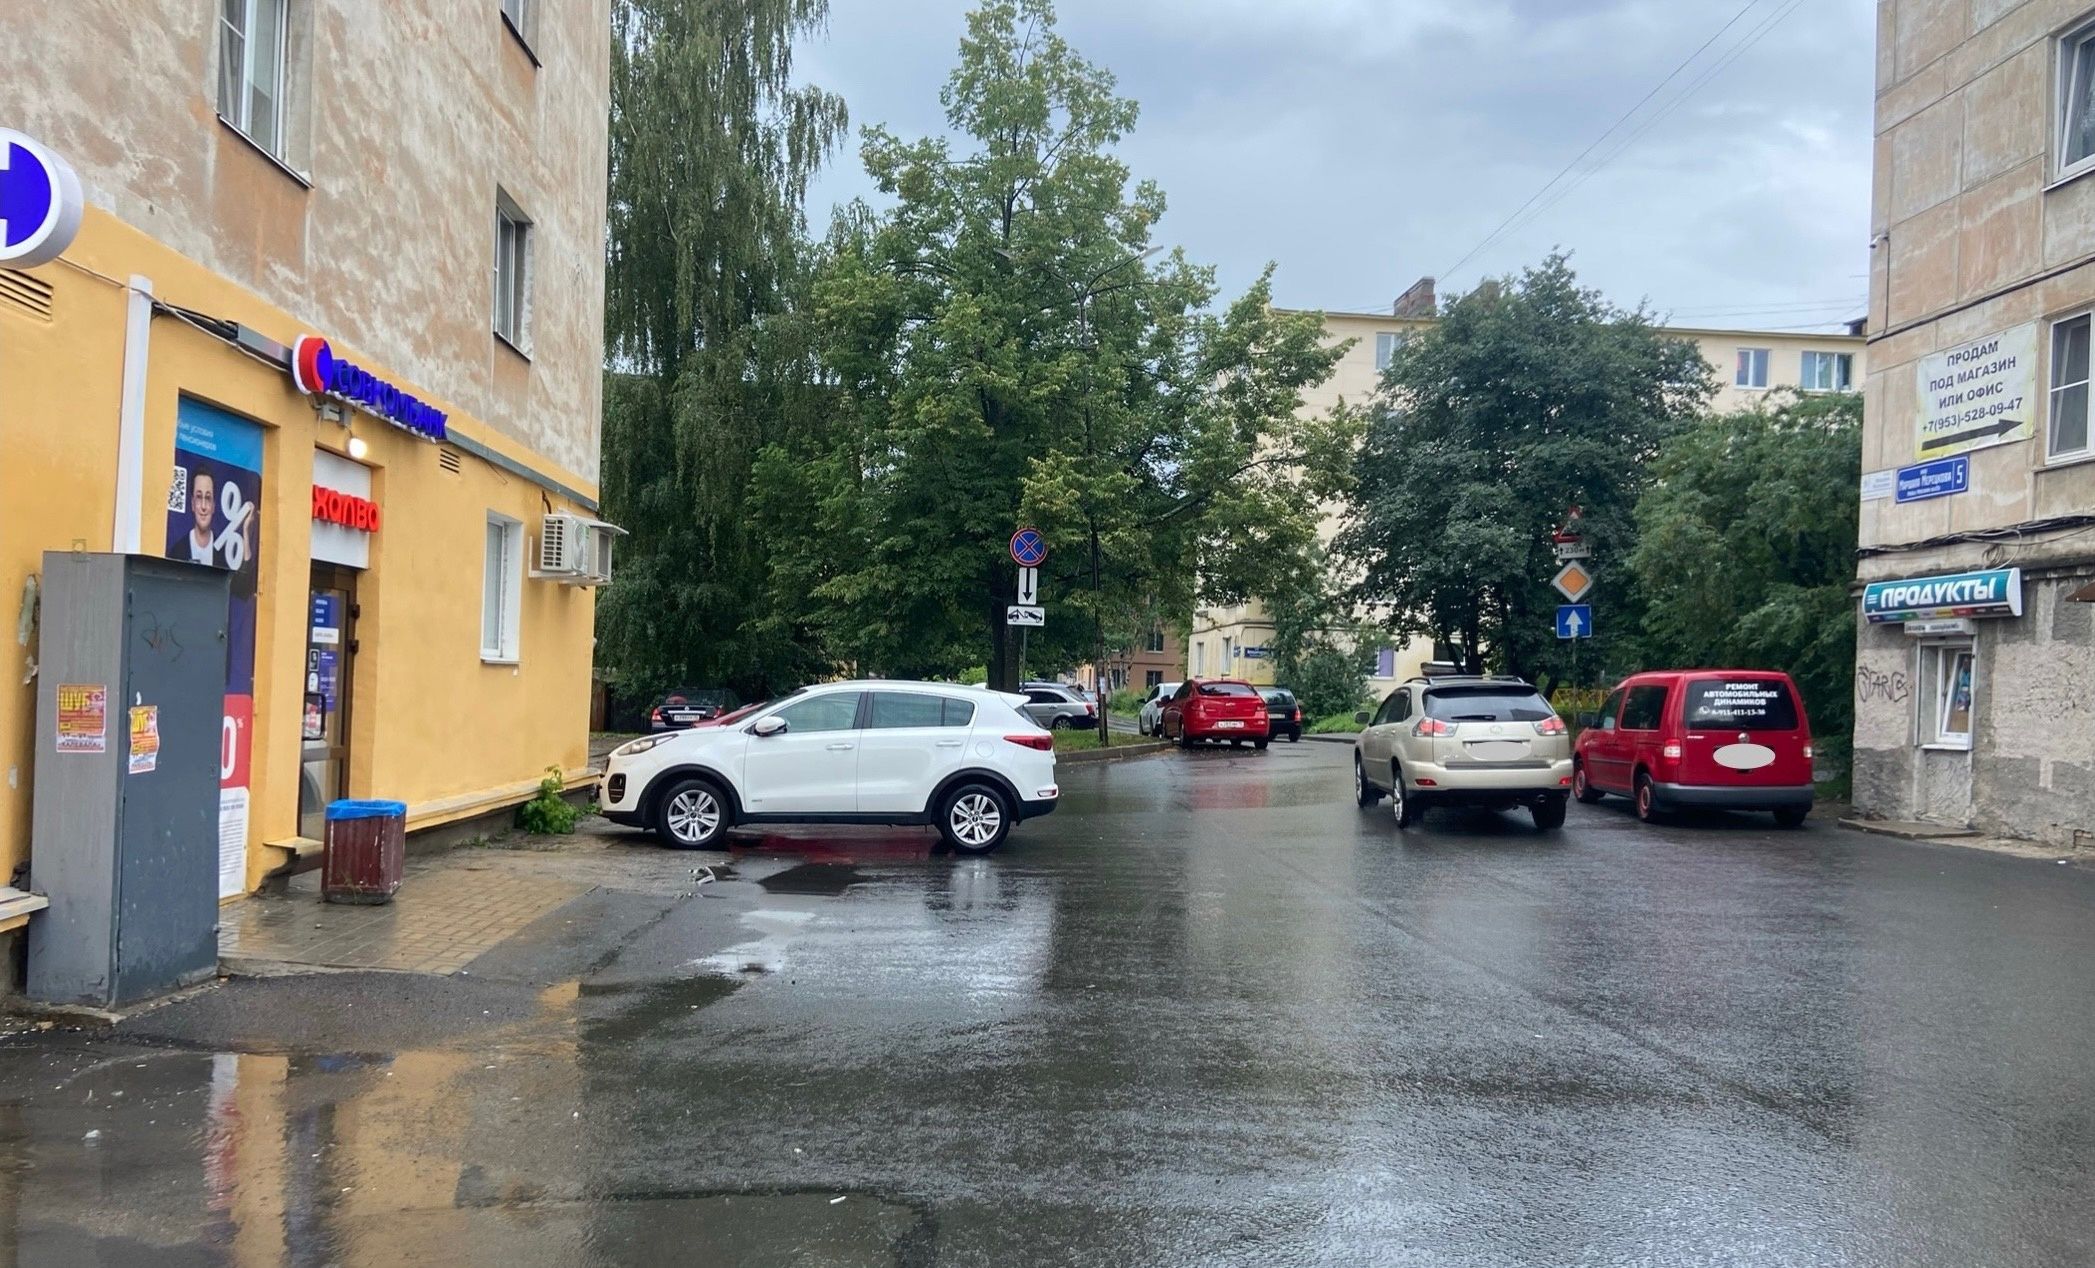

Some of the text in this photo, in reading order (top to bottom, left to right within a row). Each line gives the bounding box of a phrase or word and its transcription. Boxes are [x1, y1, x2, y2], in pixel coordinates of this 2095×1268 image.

[1947, 340, 1999, 366] ПРОДАМ
[1929, 356, 2017, 393] ПОД МАГАЗИН
[1939, 381, 2004, 409] ИЛИ ОФИС
[1922, 397, 2023, 432] +7(953)-528-09-47
[1956, 464, 1964, 484] 5
[1881, 577, 1996, 608] ПРОДУКТЫ
[1703, 690, 1778, 698] АВТОМОБИЛЬНЫХ
[1713, 698, 1767, 706] ДИНАМИКОВ
